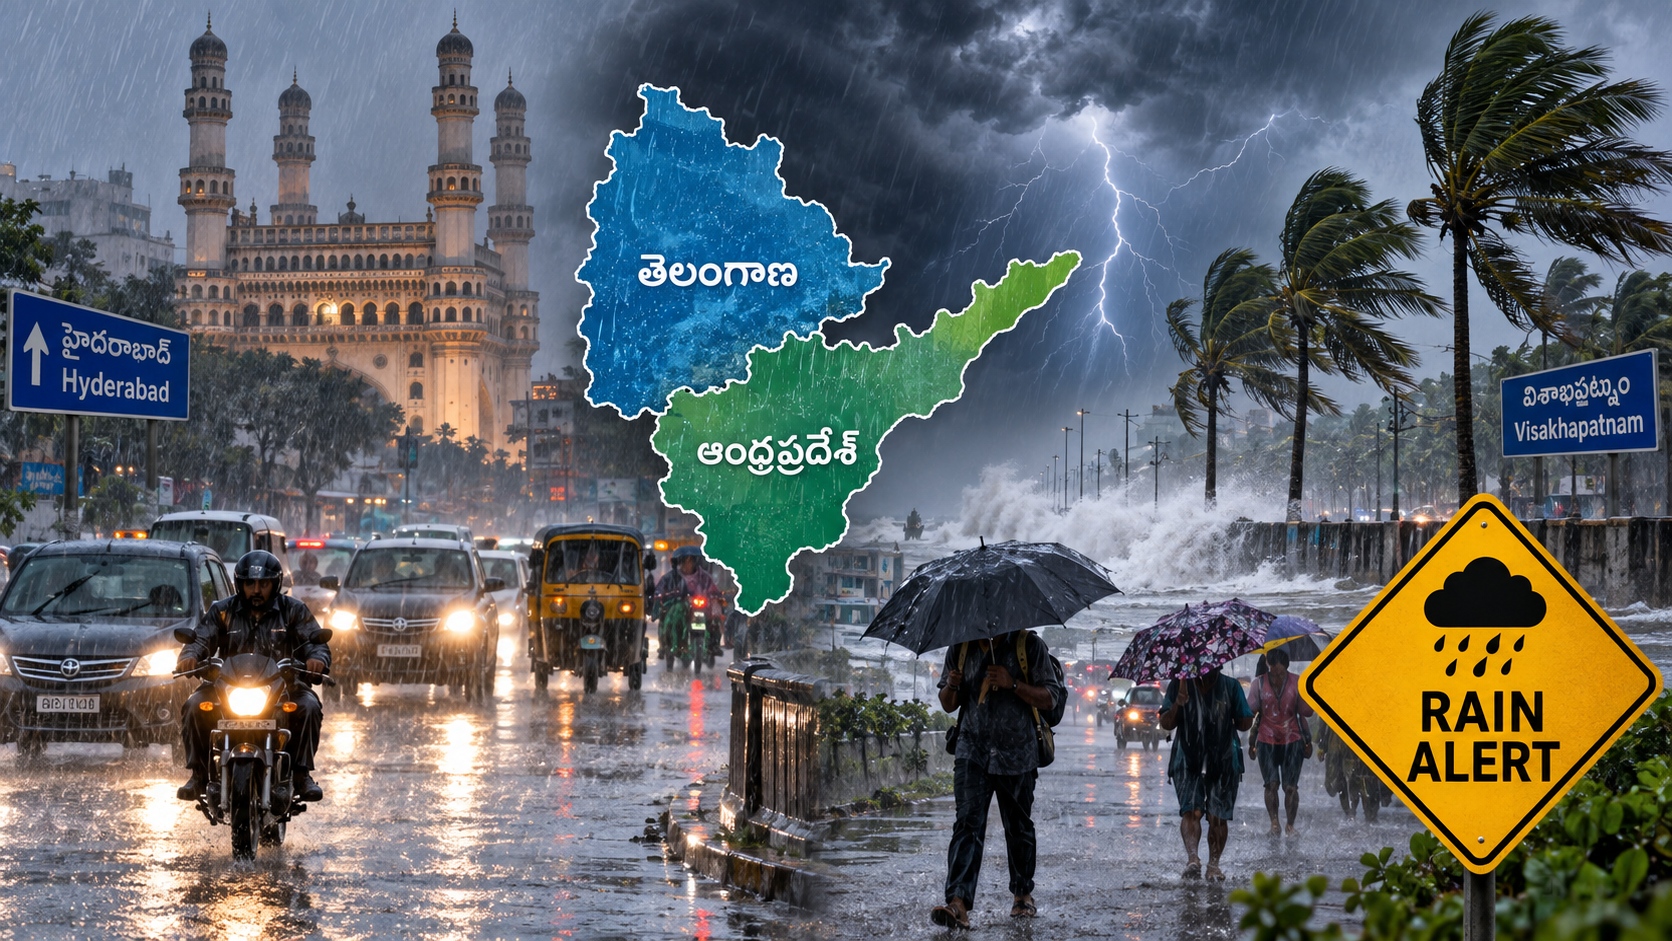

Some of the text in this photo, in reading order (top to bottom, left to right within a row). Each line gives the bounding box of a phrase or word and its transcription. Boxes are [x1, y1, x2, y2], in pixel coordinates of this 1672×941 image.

[62, 367, 169, 403] Hyderabad
[1514, 413, 1644, 443] Visakhapatnam
[1422, 691, 1543, 732] RAIN
[1407, 741, 1560, 782] ALERT
